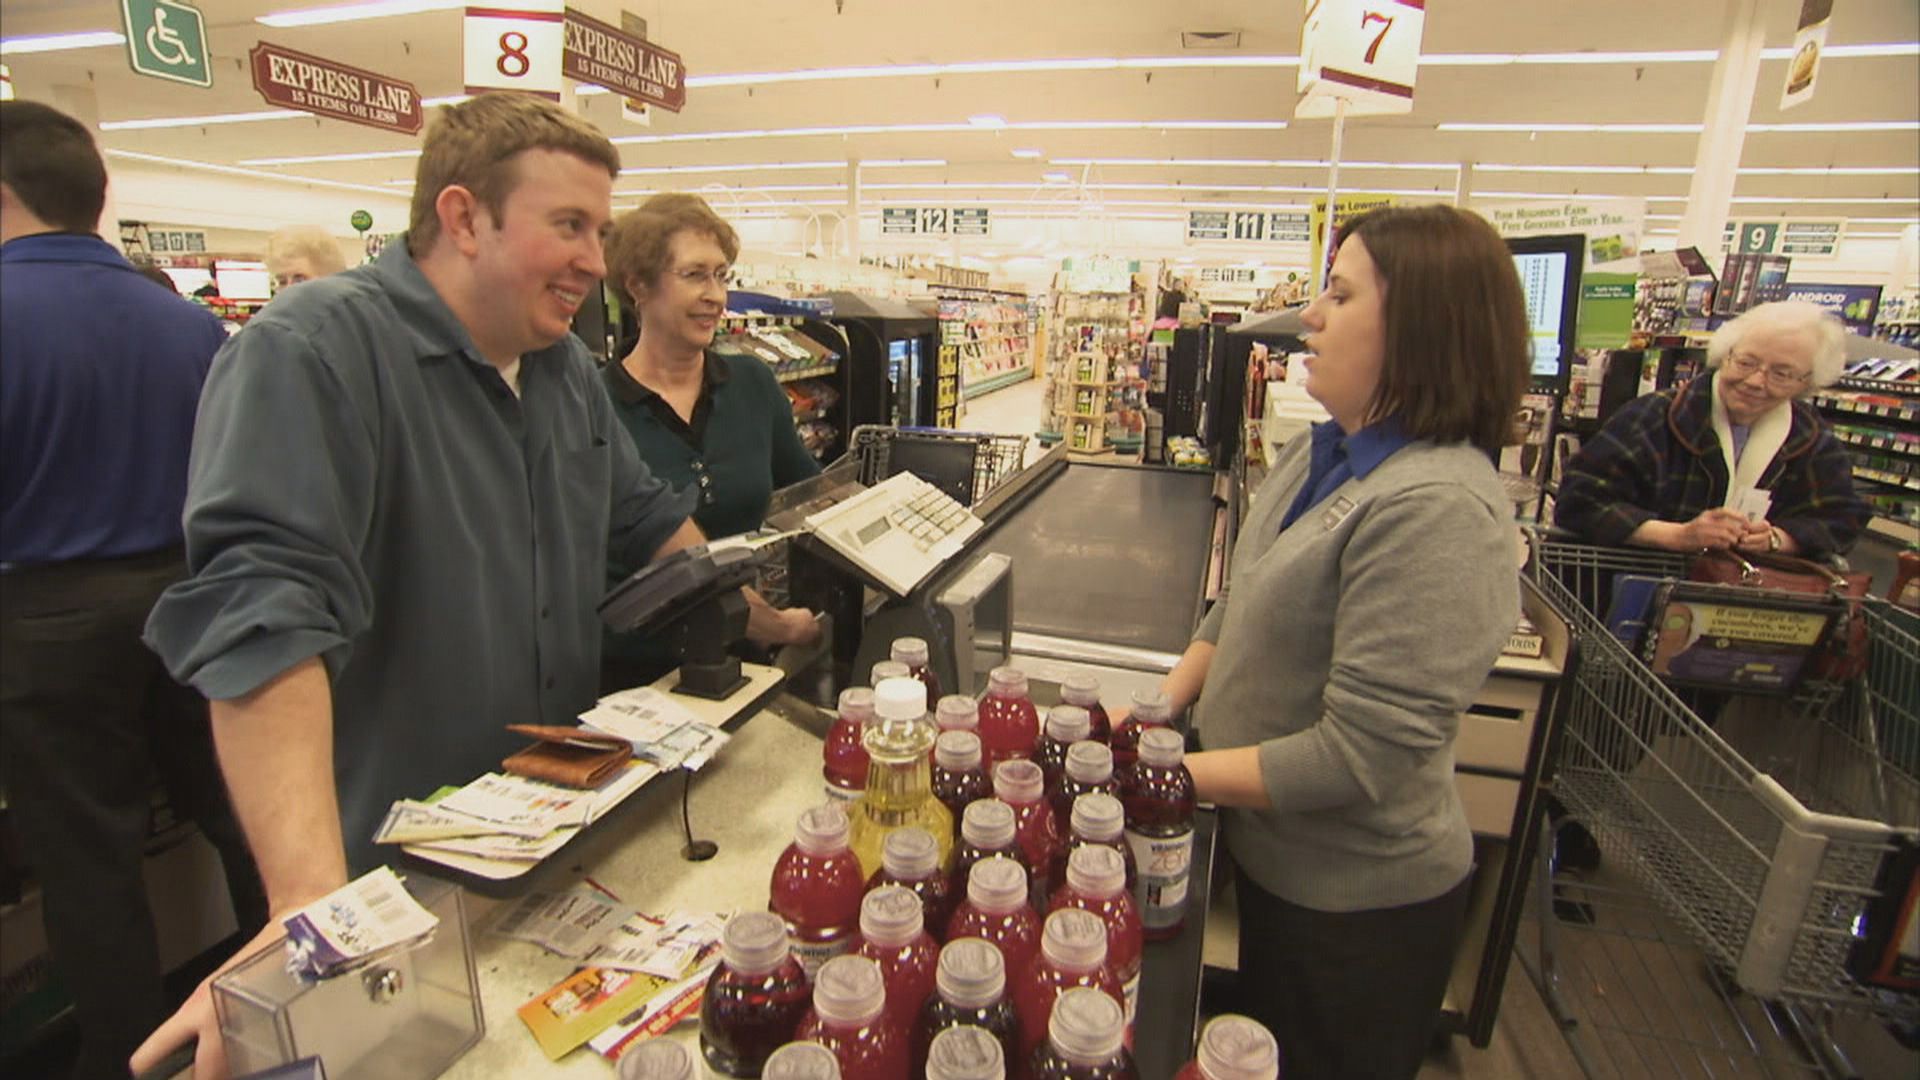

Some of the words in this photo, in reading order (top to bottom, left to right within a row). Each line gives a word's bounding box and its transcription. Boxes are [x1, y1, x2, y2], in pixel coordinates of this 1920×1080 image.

[497, 32, 530, 77] 8
[565, 19, 635, 71] EXPRESS
[638, 49, 677, 89] LANE
[1361, 10, 1393, 64] 7
[267, 53, 360, 101] EXPRESS
[363, 80, 412, 115] LANE
[577, 59, 588, 74] 15
[591, 63, 624, 84] ITEMS
[625, 75, 640, 91] OR
[641, 82, 665, 99] LESS
[291, 90, 305, 103] 15
[308, 93, 348, 113] ITEMS
[350, 103, 367, 118] OR
[369, 108, 398, 124] LESS
[922, 208, 945, 233] 12
[1238, 213, 1260, 239] 11
[1749, 227, 1767, 251] 9
[1786, 292, 1846, 304] ANDROID
